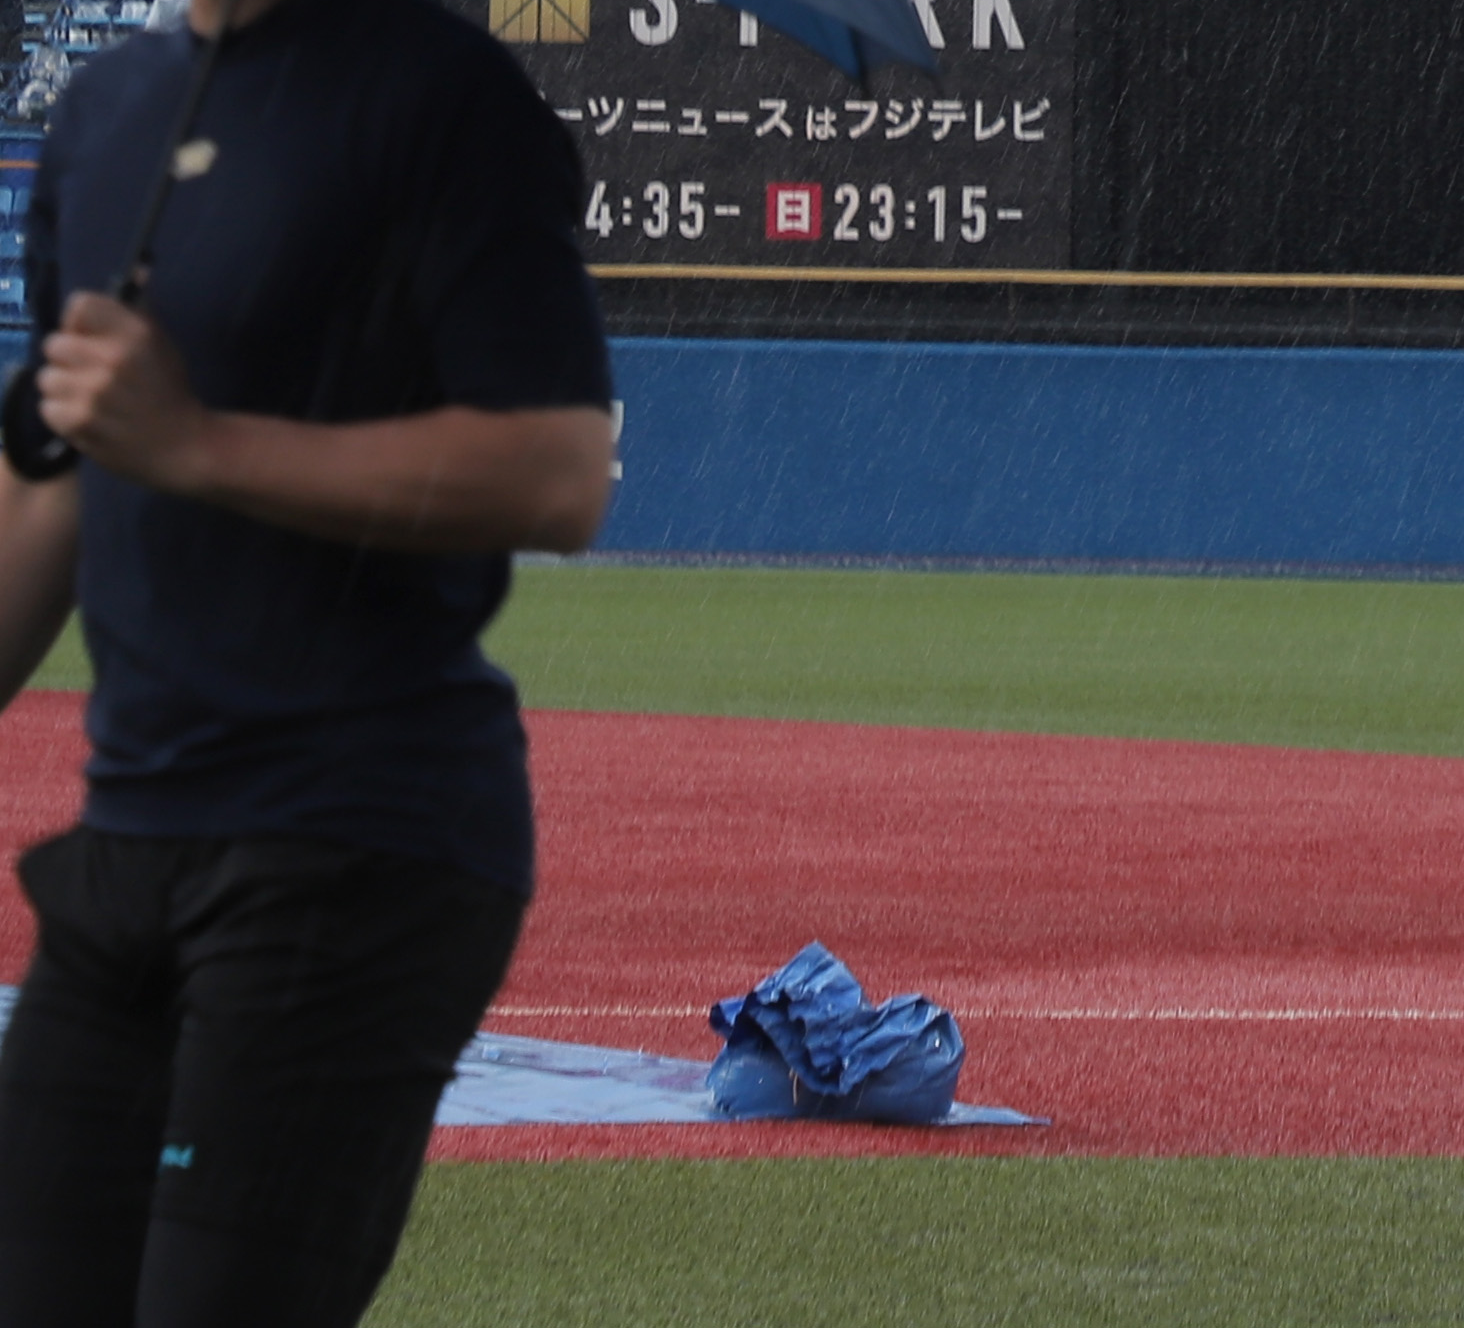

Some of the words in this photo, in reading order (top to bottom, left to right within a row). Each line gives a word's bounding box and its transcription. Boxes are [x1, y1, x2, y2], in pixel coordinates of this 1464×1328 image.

[539, 92, 1052, 143] ーツニュースはフジテレビ
